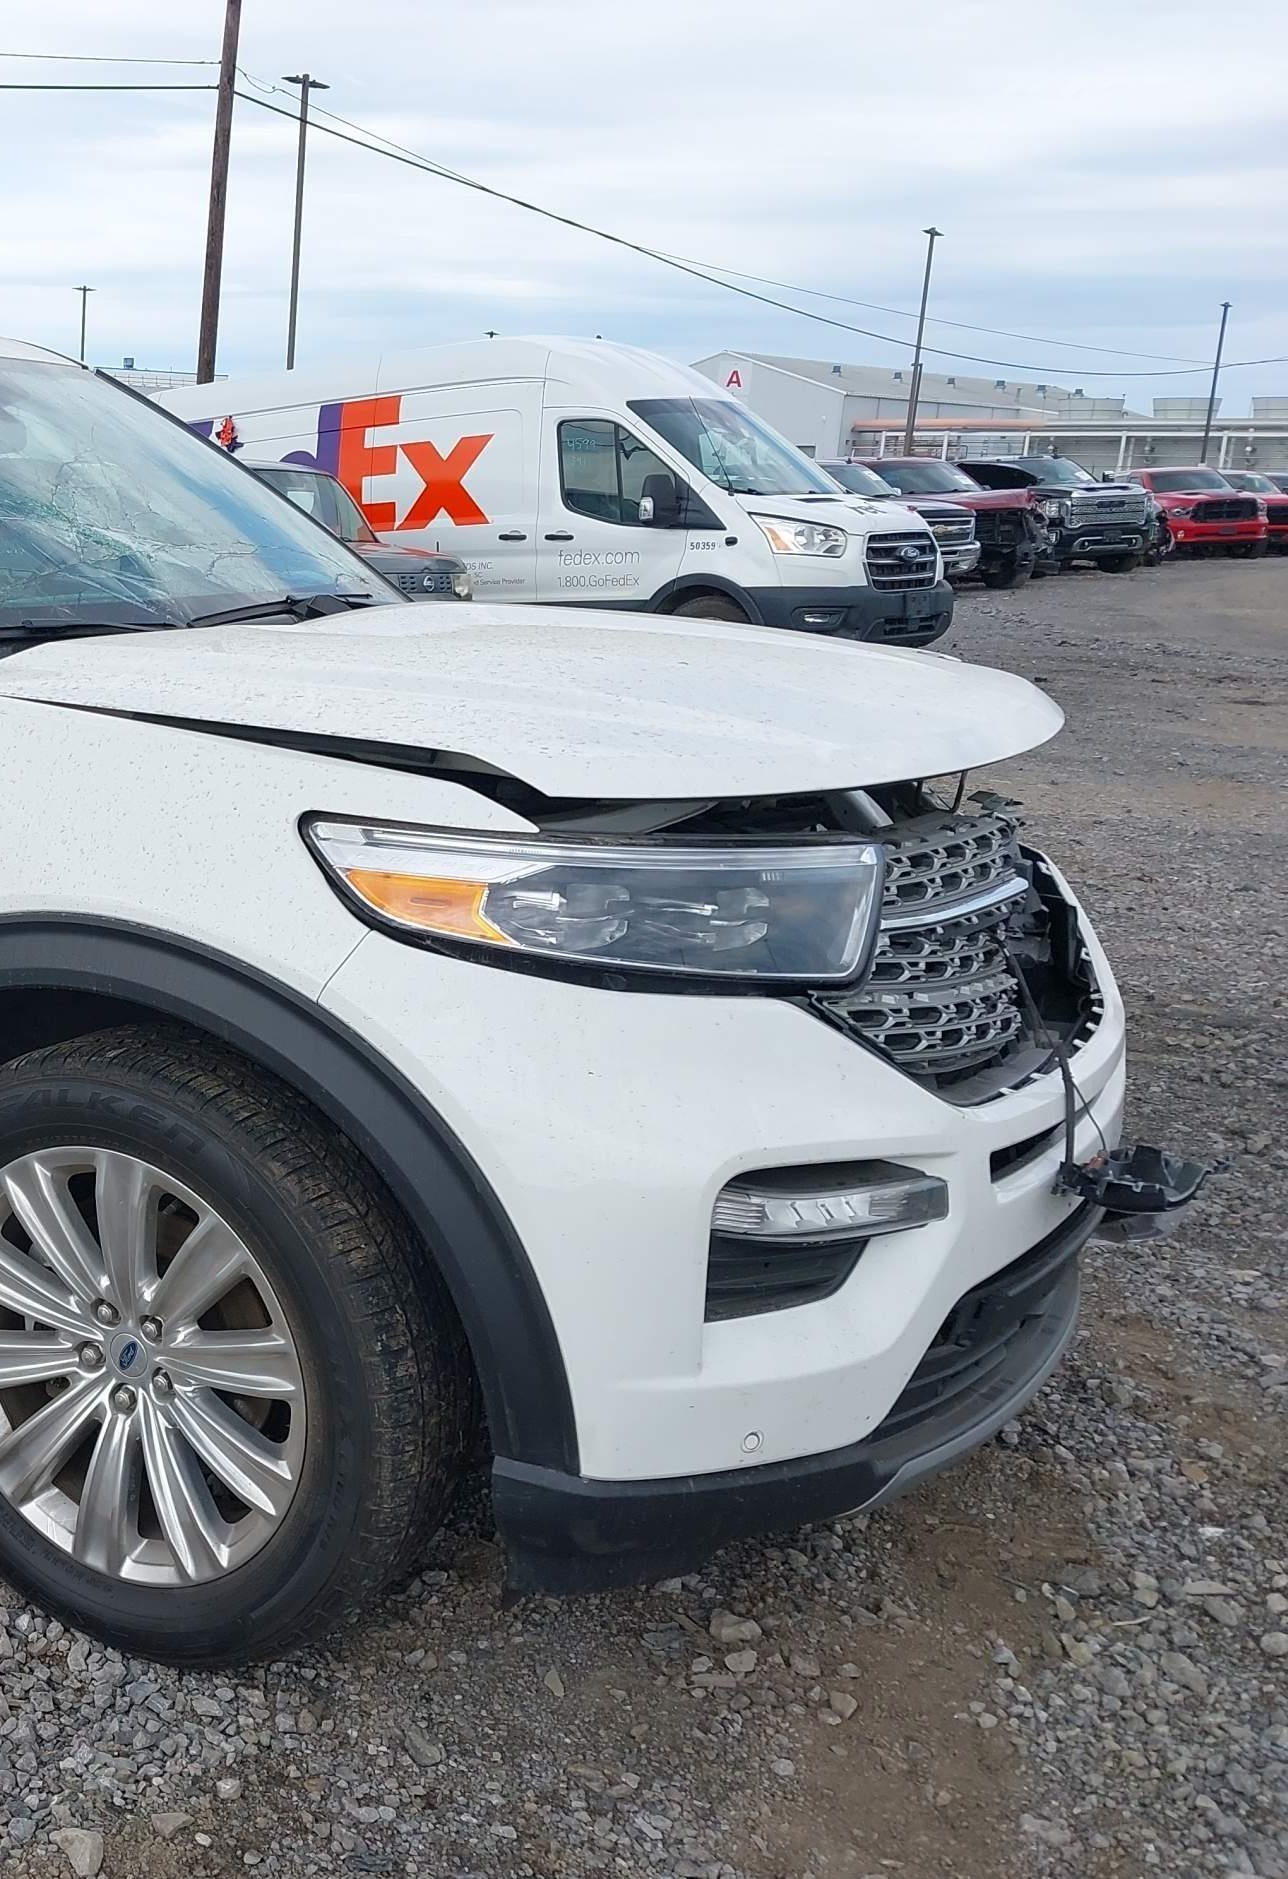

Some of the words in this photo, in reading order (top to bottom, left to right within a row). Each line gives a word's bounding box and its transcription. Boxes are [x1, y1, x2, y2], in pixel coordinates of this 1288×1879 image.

[725, 370, 742, 388] A
[689, 541, 716, 551] 50359
[557, 549, 640, 567] fedex.com
[557, 573, 640, 588] 1.800.GoFedEx
